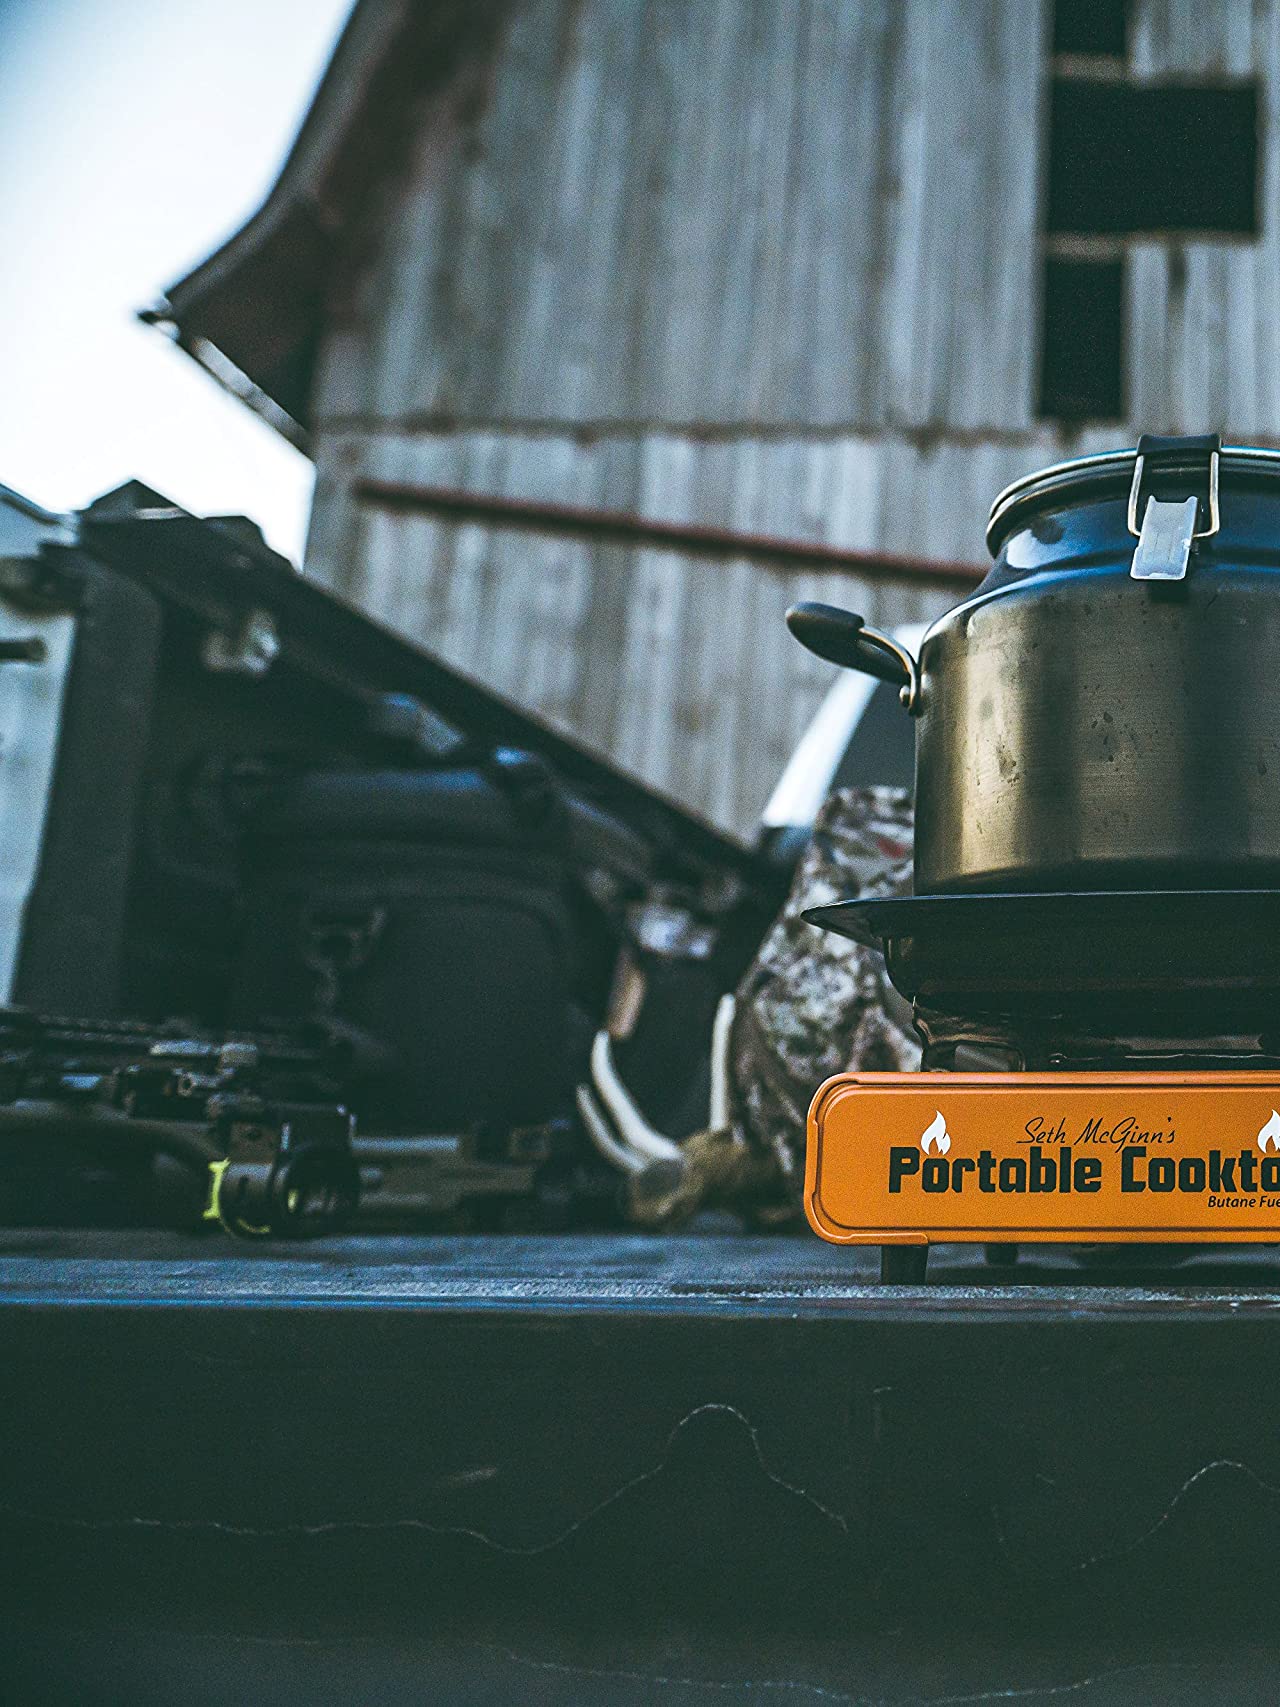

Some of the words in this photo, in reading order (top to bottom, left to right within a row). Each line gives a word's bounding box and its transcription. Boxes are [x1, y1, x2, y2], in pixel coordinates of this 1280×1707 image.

[1016, 1116, 1066, 1144] Seth
[1073, 1116, 1176, 1152] McGinn's
[888, 1146, 1102, 1194] Portable
[1207, 1195, 1257, 1209] Butane
